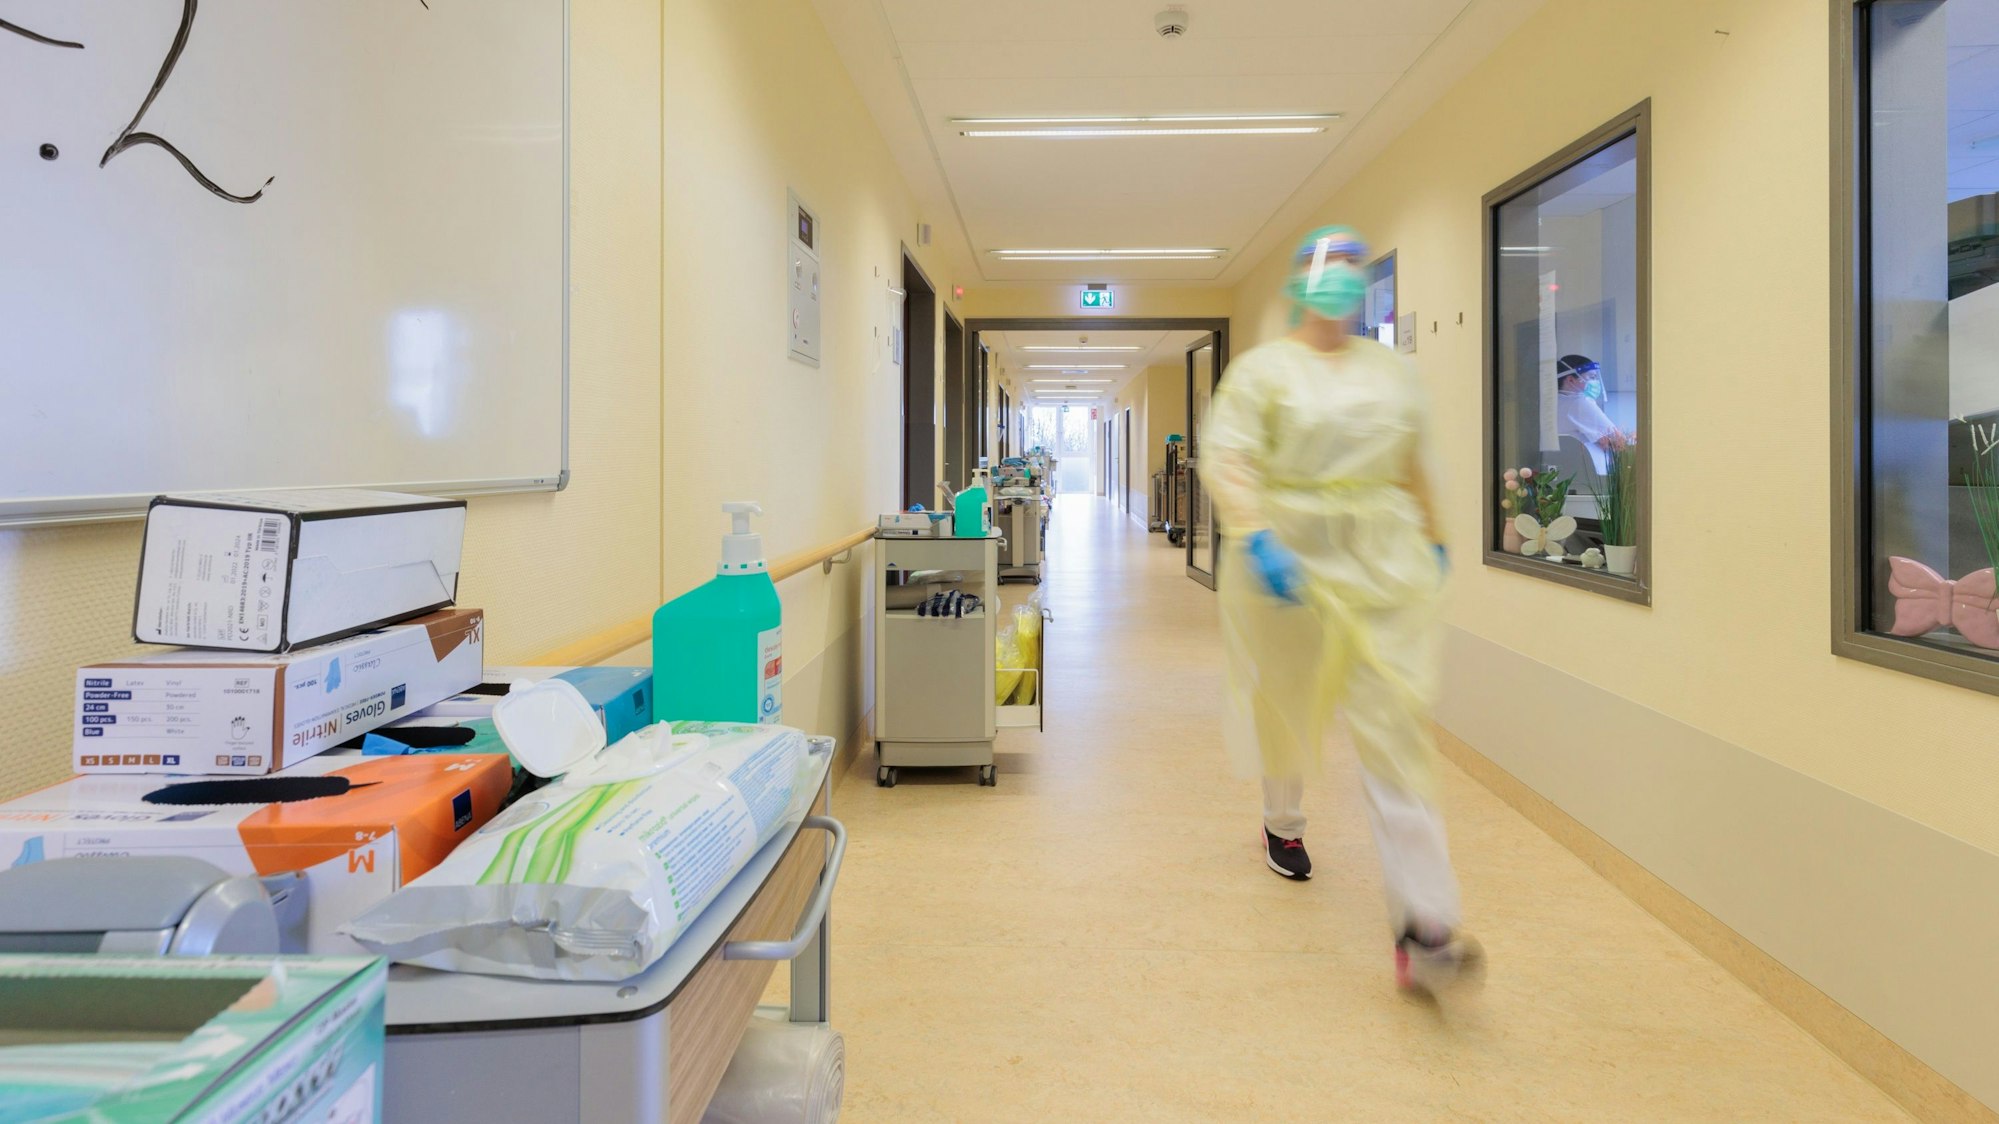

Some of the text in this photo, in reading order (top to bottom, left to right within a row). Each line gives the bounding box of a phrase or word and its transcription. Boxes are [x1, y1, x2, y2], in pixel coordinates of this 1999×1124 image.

[465, 627, 480, 644] XL
[292, 700, 386, 748] Gloves Nitrile
[355, 831, 376, 841] 7-8
[348, 848, 375, 874] M
